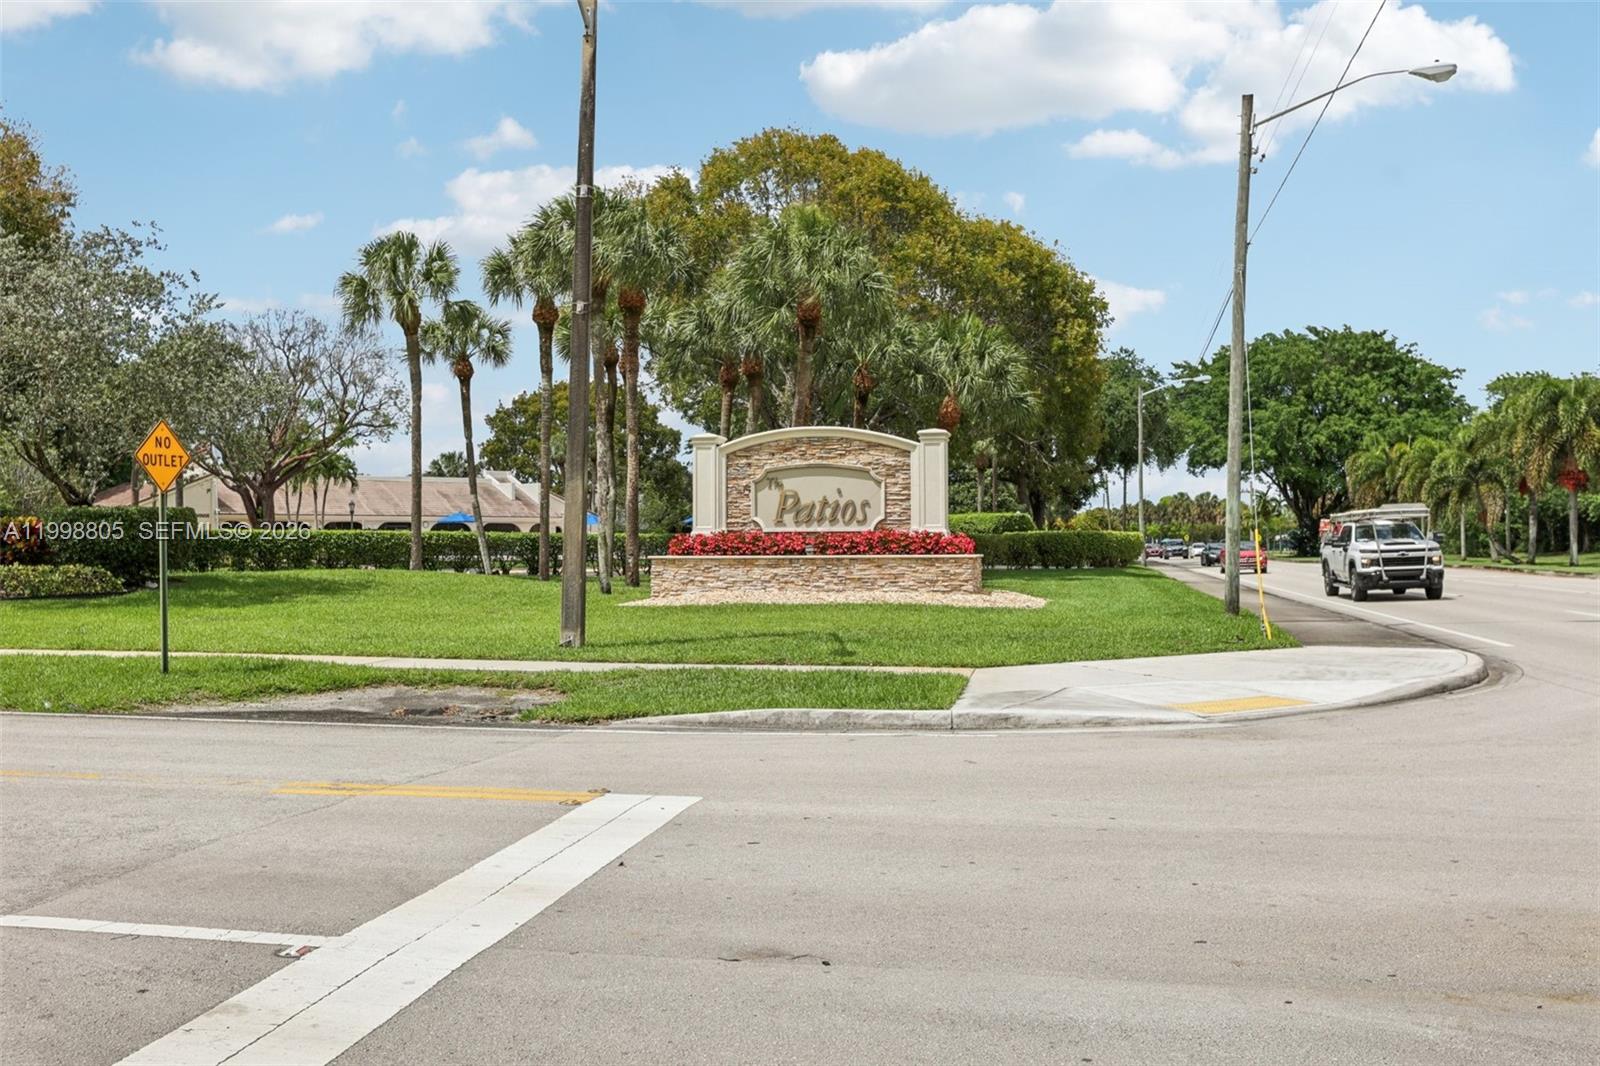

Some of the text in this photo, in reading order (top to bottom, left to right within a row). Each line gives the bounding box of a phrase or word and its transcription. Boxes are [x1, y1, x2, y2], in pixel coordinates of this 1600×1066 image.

[155, 436, 171, 449] NO
[142, 453, 184, 468] OUTLET
[773, 488, 871, 527] Patios
